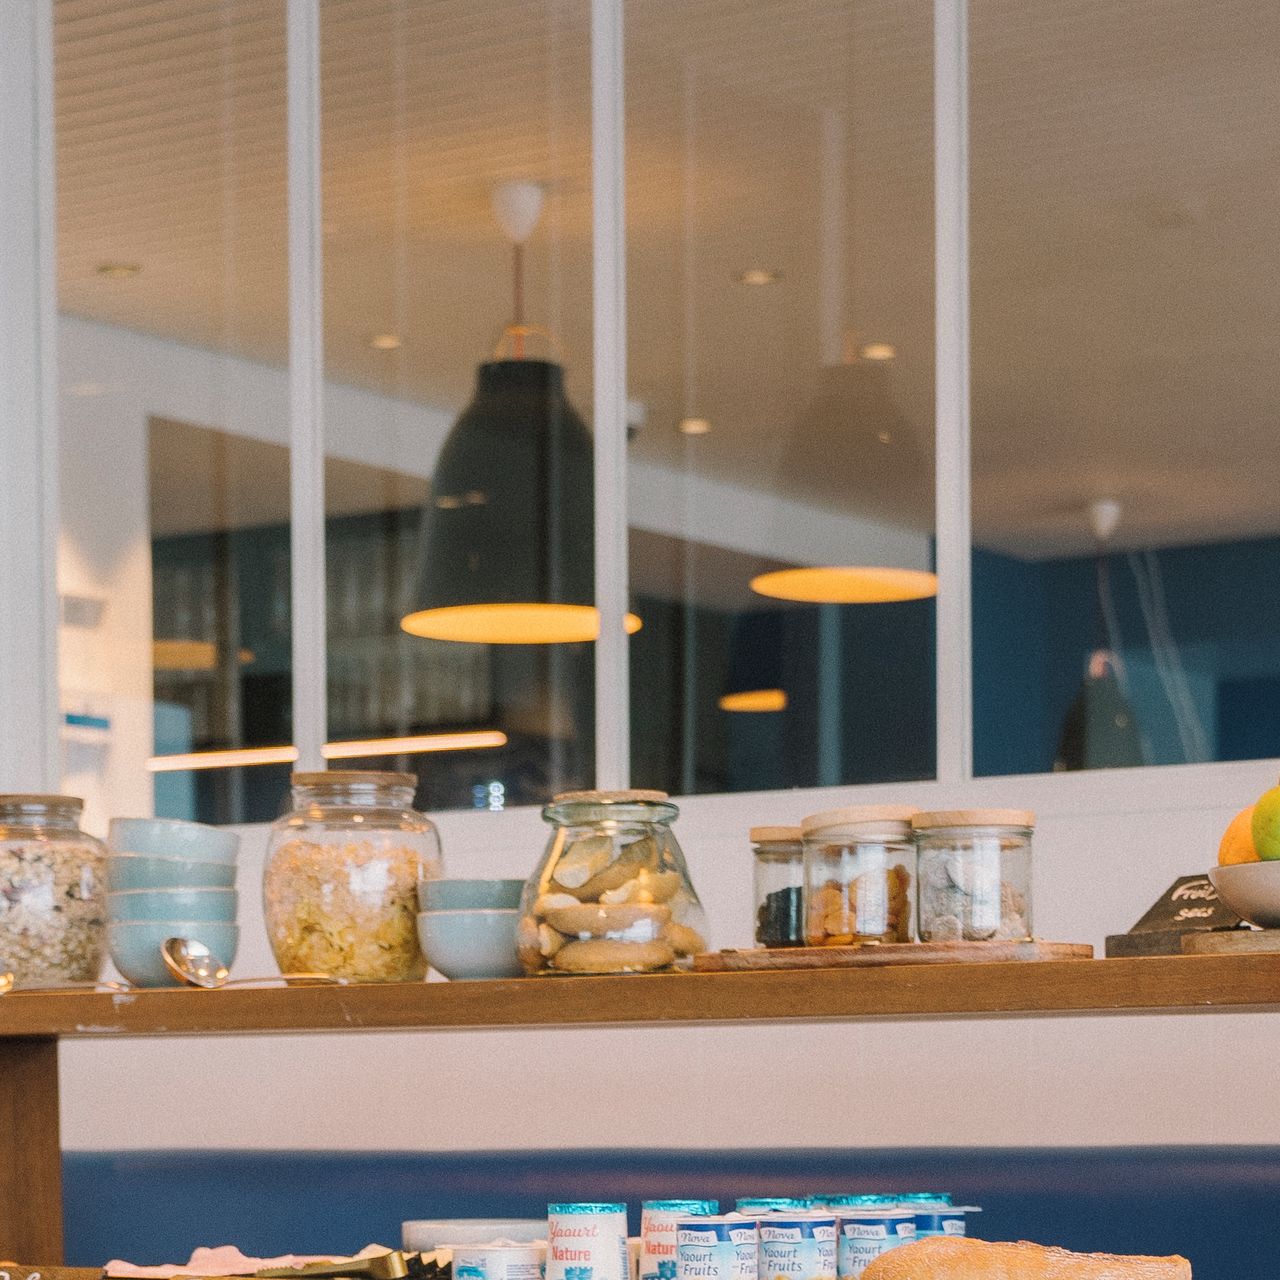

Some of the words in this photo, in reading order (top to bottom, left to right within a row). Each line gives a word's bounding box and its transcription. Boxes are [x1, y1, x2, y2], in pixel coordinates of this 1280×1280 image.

[549, 1219, 599, 1241] Yaourt
[643, 1216, 675, 1238] Yaou
[680, 1232, 710, 1242] Nova
[765, 1230, 794, 1239] Nova
[552, 1245, 592, 1261] Nature
[646, 1241, 677, 1255] Natur
[763, 1247, 798, 1258] Yaourt
[848, 1244, 882, 1255] Yaourt
[680, 1251, 713, 1262] Yaourt
[683, 1262, 719, 1276] Fruits
[767, 1259, 802, 1272] Fruits
